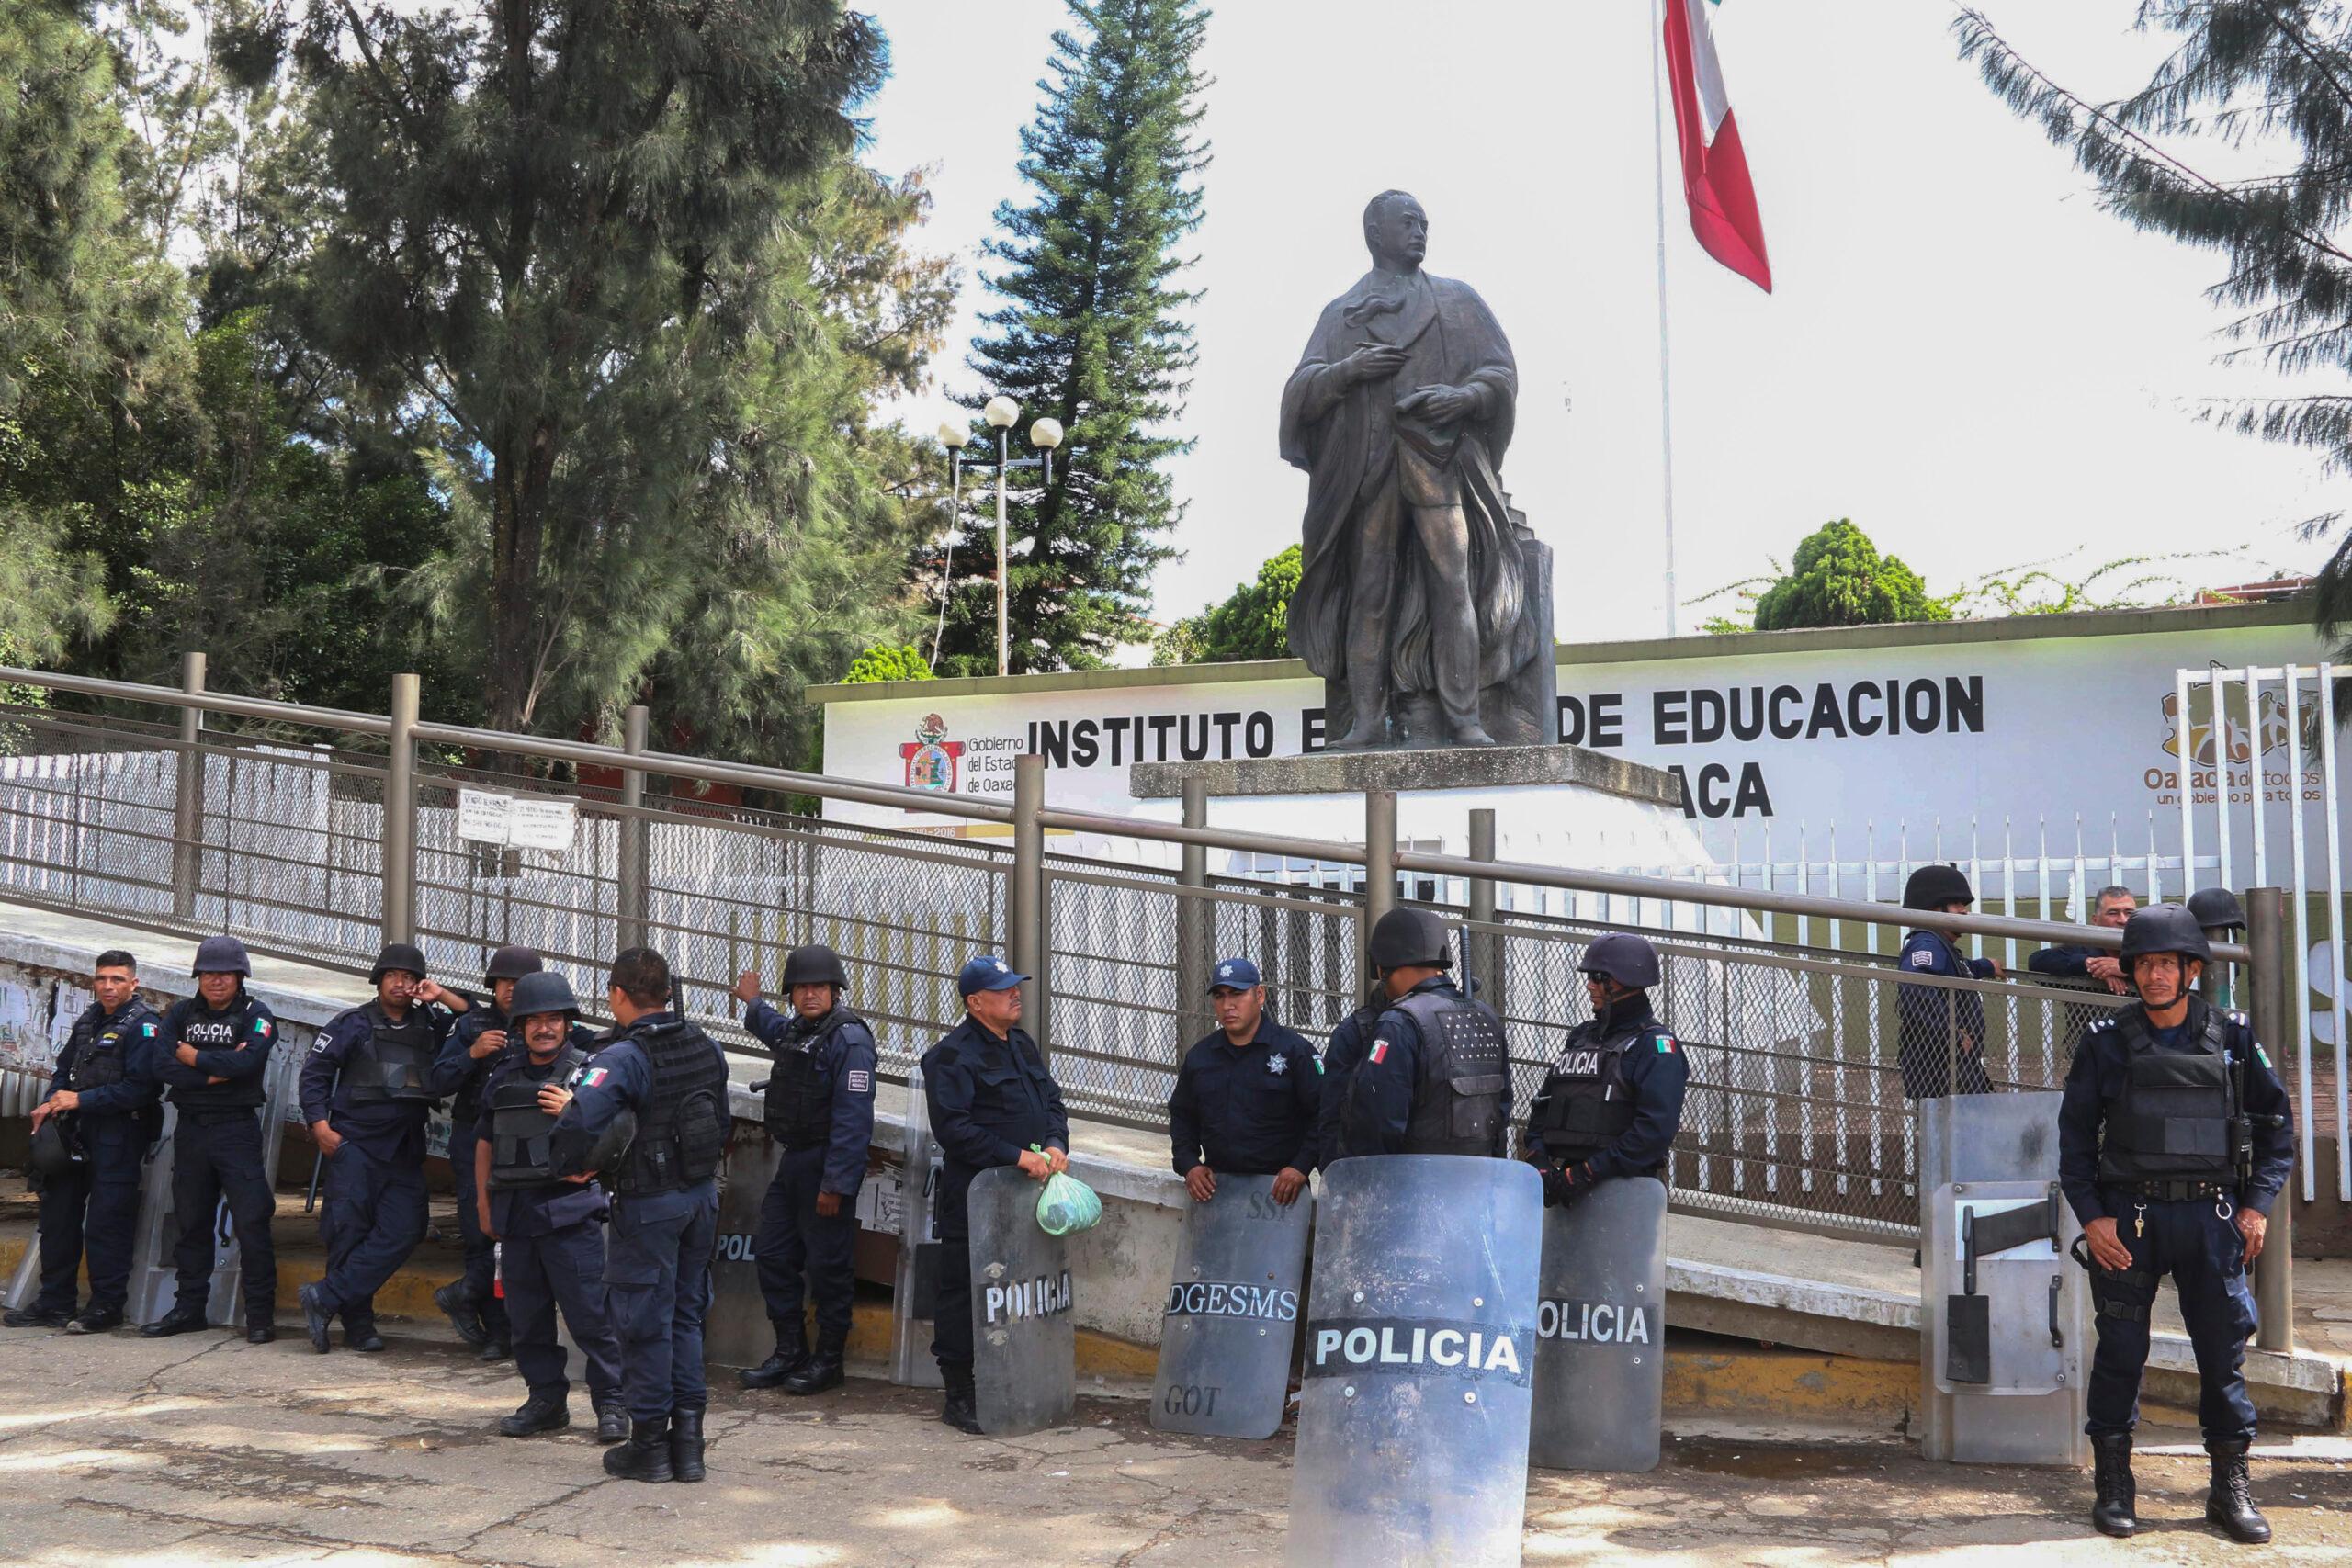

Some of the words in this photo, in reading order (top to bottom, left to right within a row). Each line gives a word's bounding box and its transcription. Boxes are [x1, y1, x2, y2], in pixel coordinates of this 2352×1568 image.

[1028, 711, 1274, 769] INSTITUTO
[1556, 693, 1623, 748] DE
[1653, 676, 1984, 745] EDUCACION
[968, 737, 1023, 751] Gobierno
[968, 758, 981, 772] del
[968, 778, 979, 793] de
[983, 779, 1015, 793] Oaxa
[1668, 761, 1774, 819] ACA
[2143, 768, 2235, 790] Oaaca
[2263, 769, 2320, 786] toos
[2157, 794, 2174, 805] un
[2278, 789, 2321, 802] toos
[187, 1023, 232, 1037] POLICIA
[187, 1035, 232, 1043] ESTATAL
[1553, 1051, 1598, 1075] POLICIA
[986, 1273, 1070, 1323] POLICIA
[1167, 1284, 1297, 1321] DGESMS
[1537, 1301, 1649, 1344] OLICIA
[1315, 1327, 1521, 1374] POLICIA
[1164, 1385, 1222, 1417] GOT
